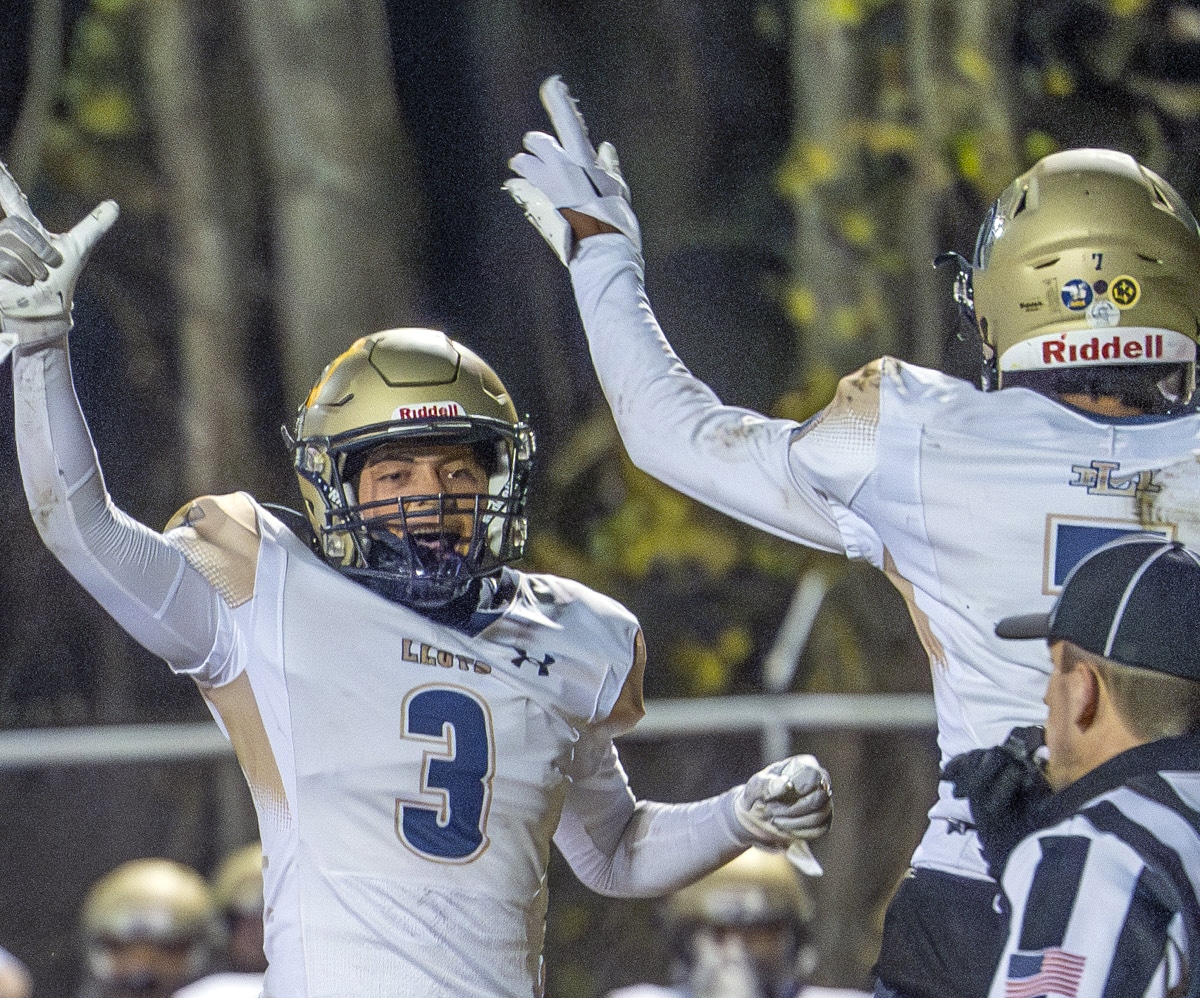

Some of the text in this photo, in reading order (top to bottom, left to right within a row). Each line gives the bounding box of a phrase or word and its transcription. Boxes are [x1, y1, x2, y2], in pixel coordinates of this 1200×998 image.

[1092, 253, 1104, 271] 7
[1042, 334, 1164, 365] Riddell
[394, 681, 497, 867] 3
